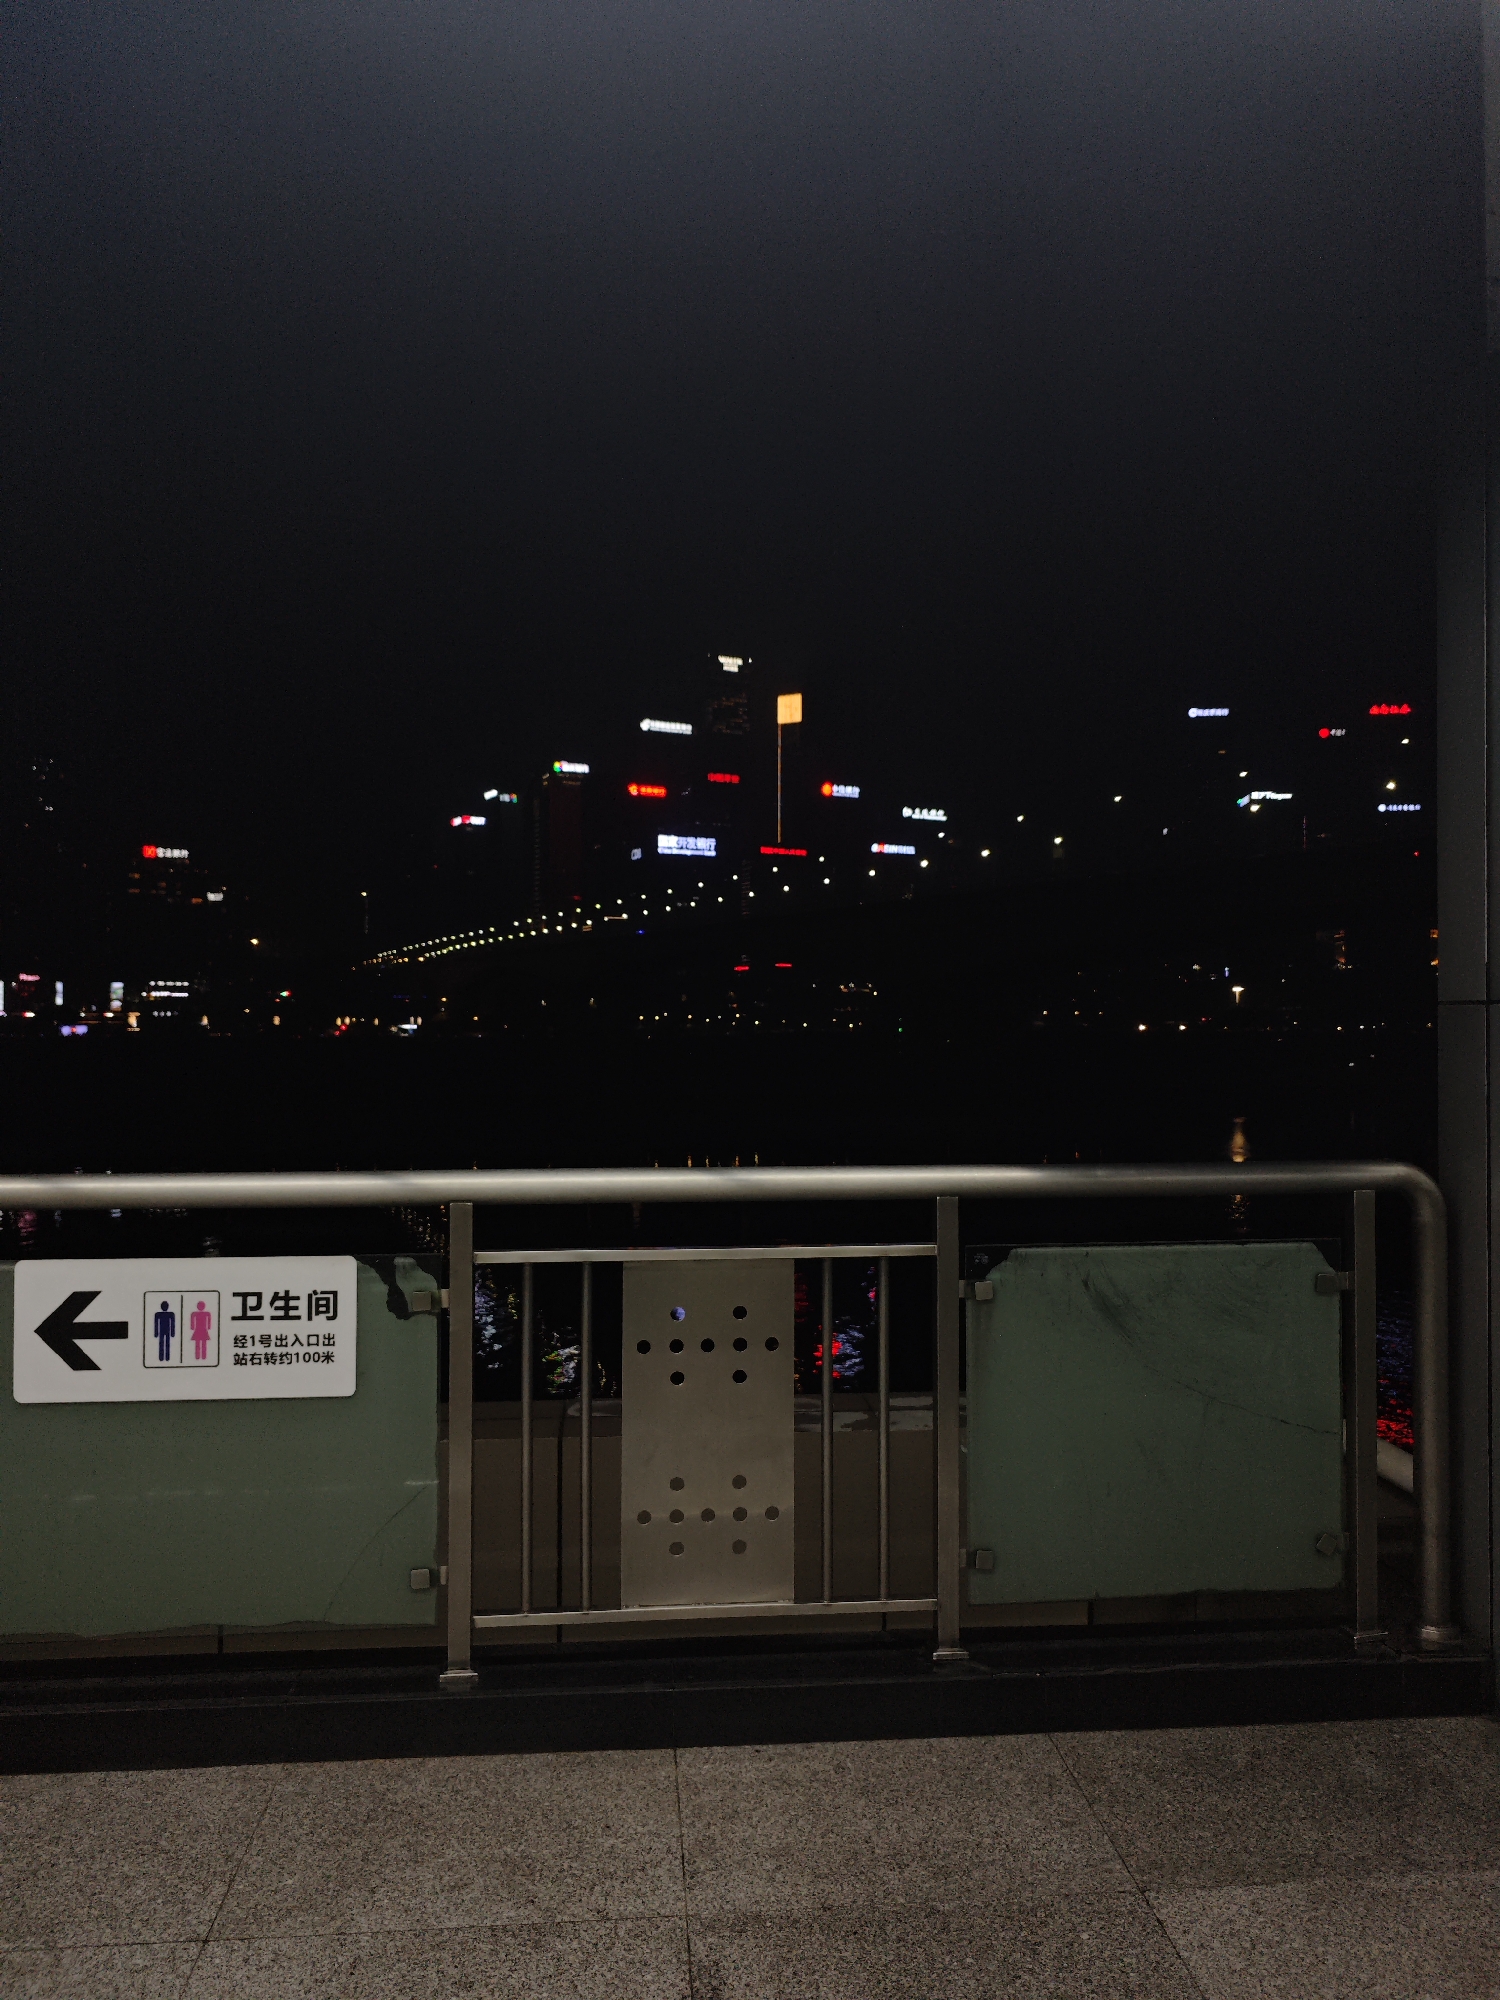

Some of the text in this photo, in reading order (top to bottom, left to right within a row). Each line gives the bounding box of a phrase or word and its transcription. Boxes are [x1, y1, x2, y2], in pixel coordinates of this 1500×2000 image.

[230, 1289, 338, 1321] 卫生间
[233, 1333, 336, 1348] 经1号出入口出
[233, 1351, 335, 1366] 站右转约100米
